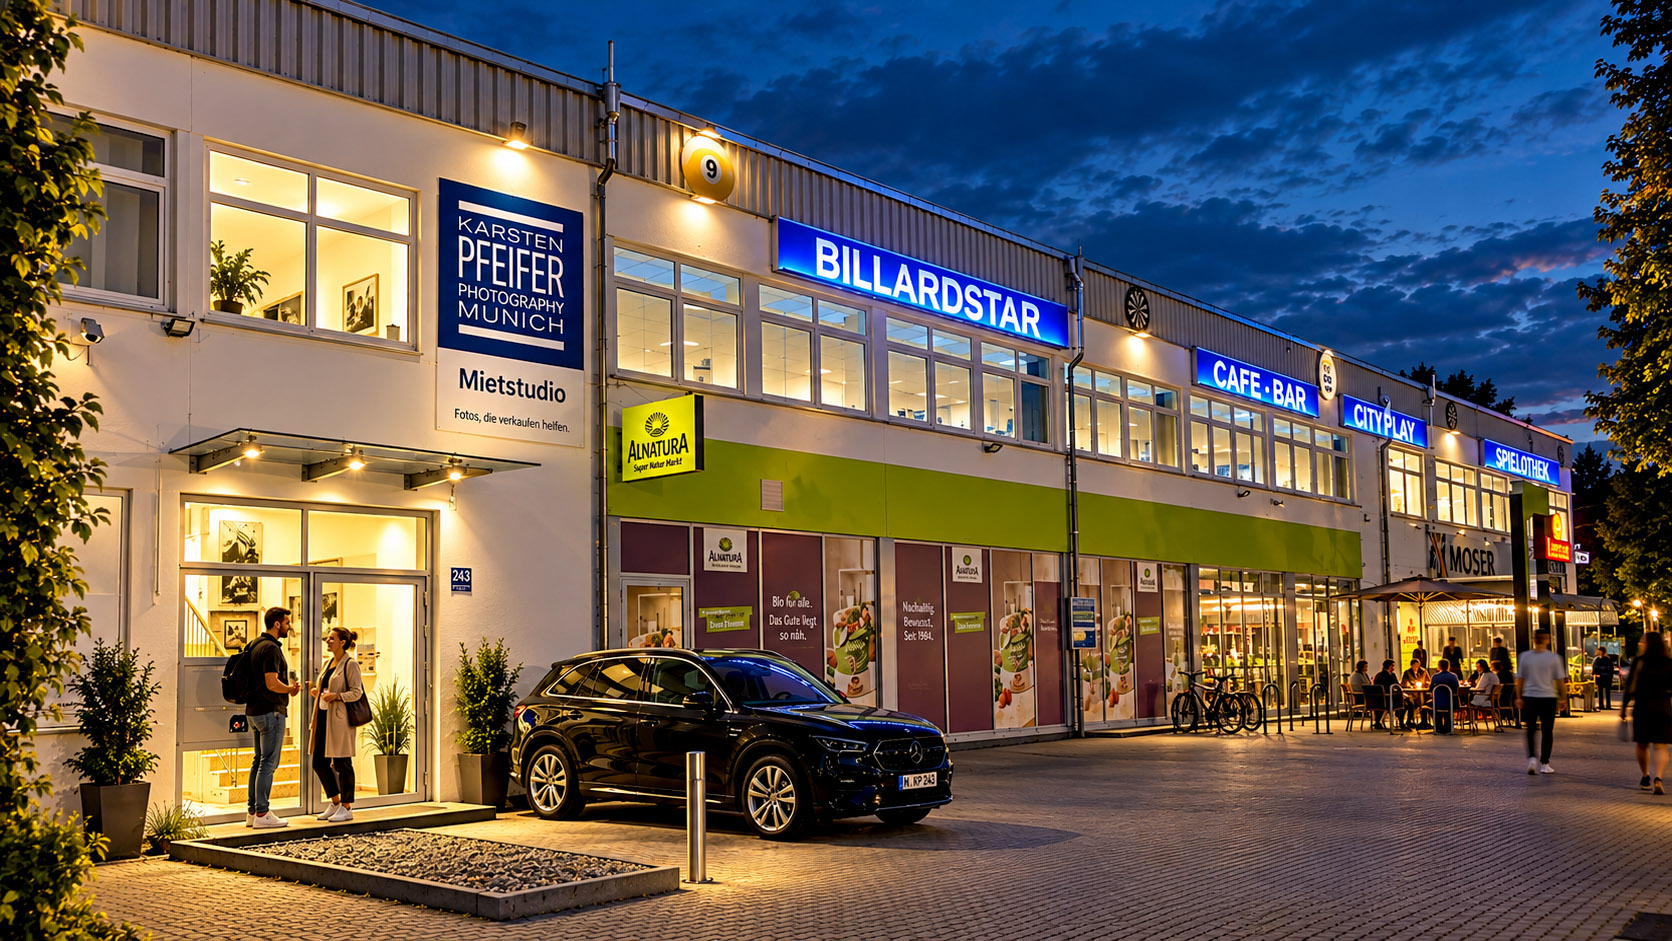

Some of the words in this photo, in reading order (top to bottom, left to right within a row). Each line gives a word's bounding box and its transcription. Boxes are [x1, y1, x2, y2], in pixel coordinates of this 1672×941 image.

[705, 158, 718, 179] 9
[458, 215, 563, 254] KARSTEN
[458, 235, 565, 298] PFEIFER
[458, 284, 564, 315] PHOTOGRAPHY
[815, 236, 1041, 339] BILLARDSTAR
[458, 300, 564, 335] MUNICH
[458, 367, 567, 404] Mietstudio
[1213, 360, 1262, 400] CAFE
[1272, 378, 1307, 413] BAR
[454, 408, 482, 424] Fotos,
[483, 412, 497, 424] die
[498, 415, 541, 430] verkaufen
[542, 419, 571, 433] helfen.
[627, 432, 690, 464] ALNATURA
[1495, 447, 1551, 482] SPIELOTHEK
[708, 549, 743, 564] ALNATURA
[1449, 544, 1496, 577] MOSER
[452, 569, 471, 583] 243
[772, 595, 785, 608] Bio
[779, 631, 789, 641] so
[783, 614, 801, 626] Gute
